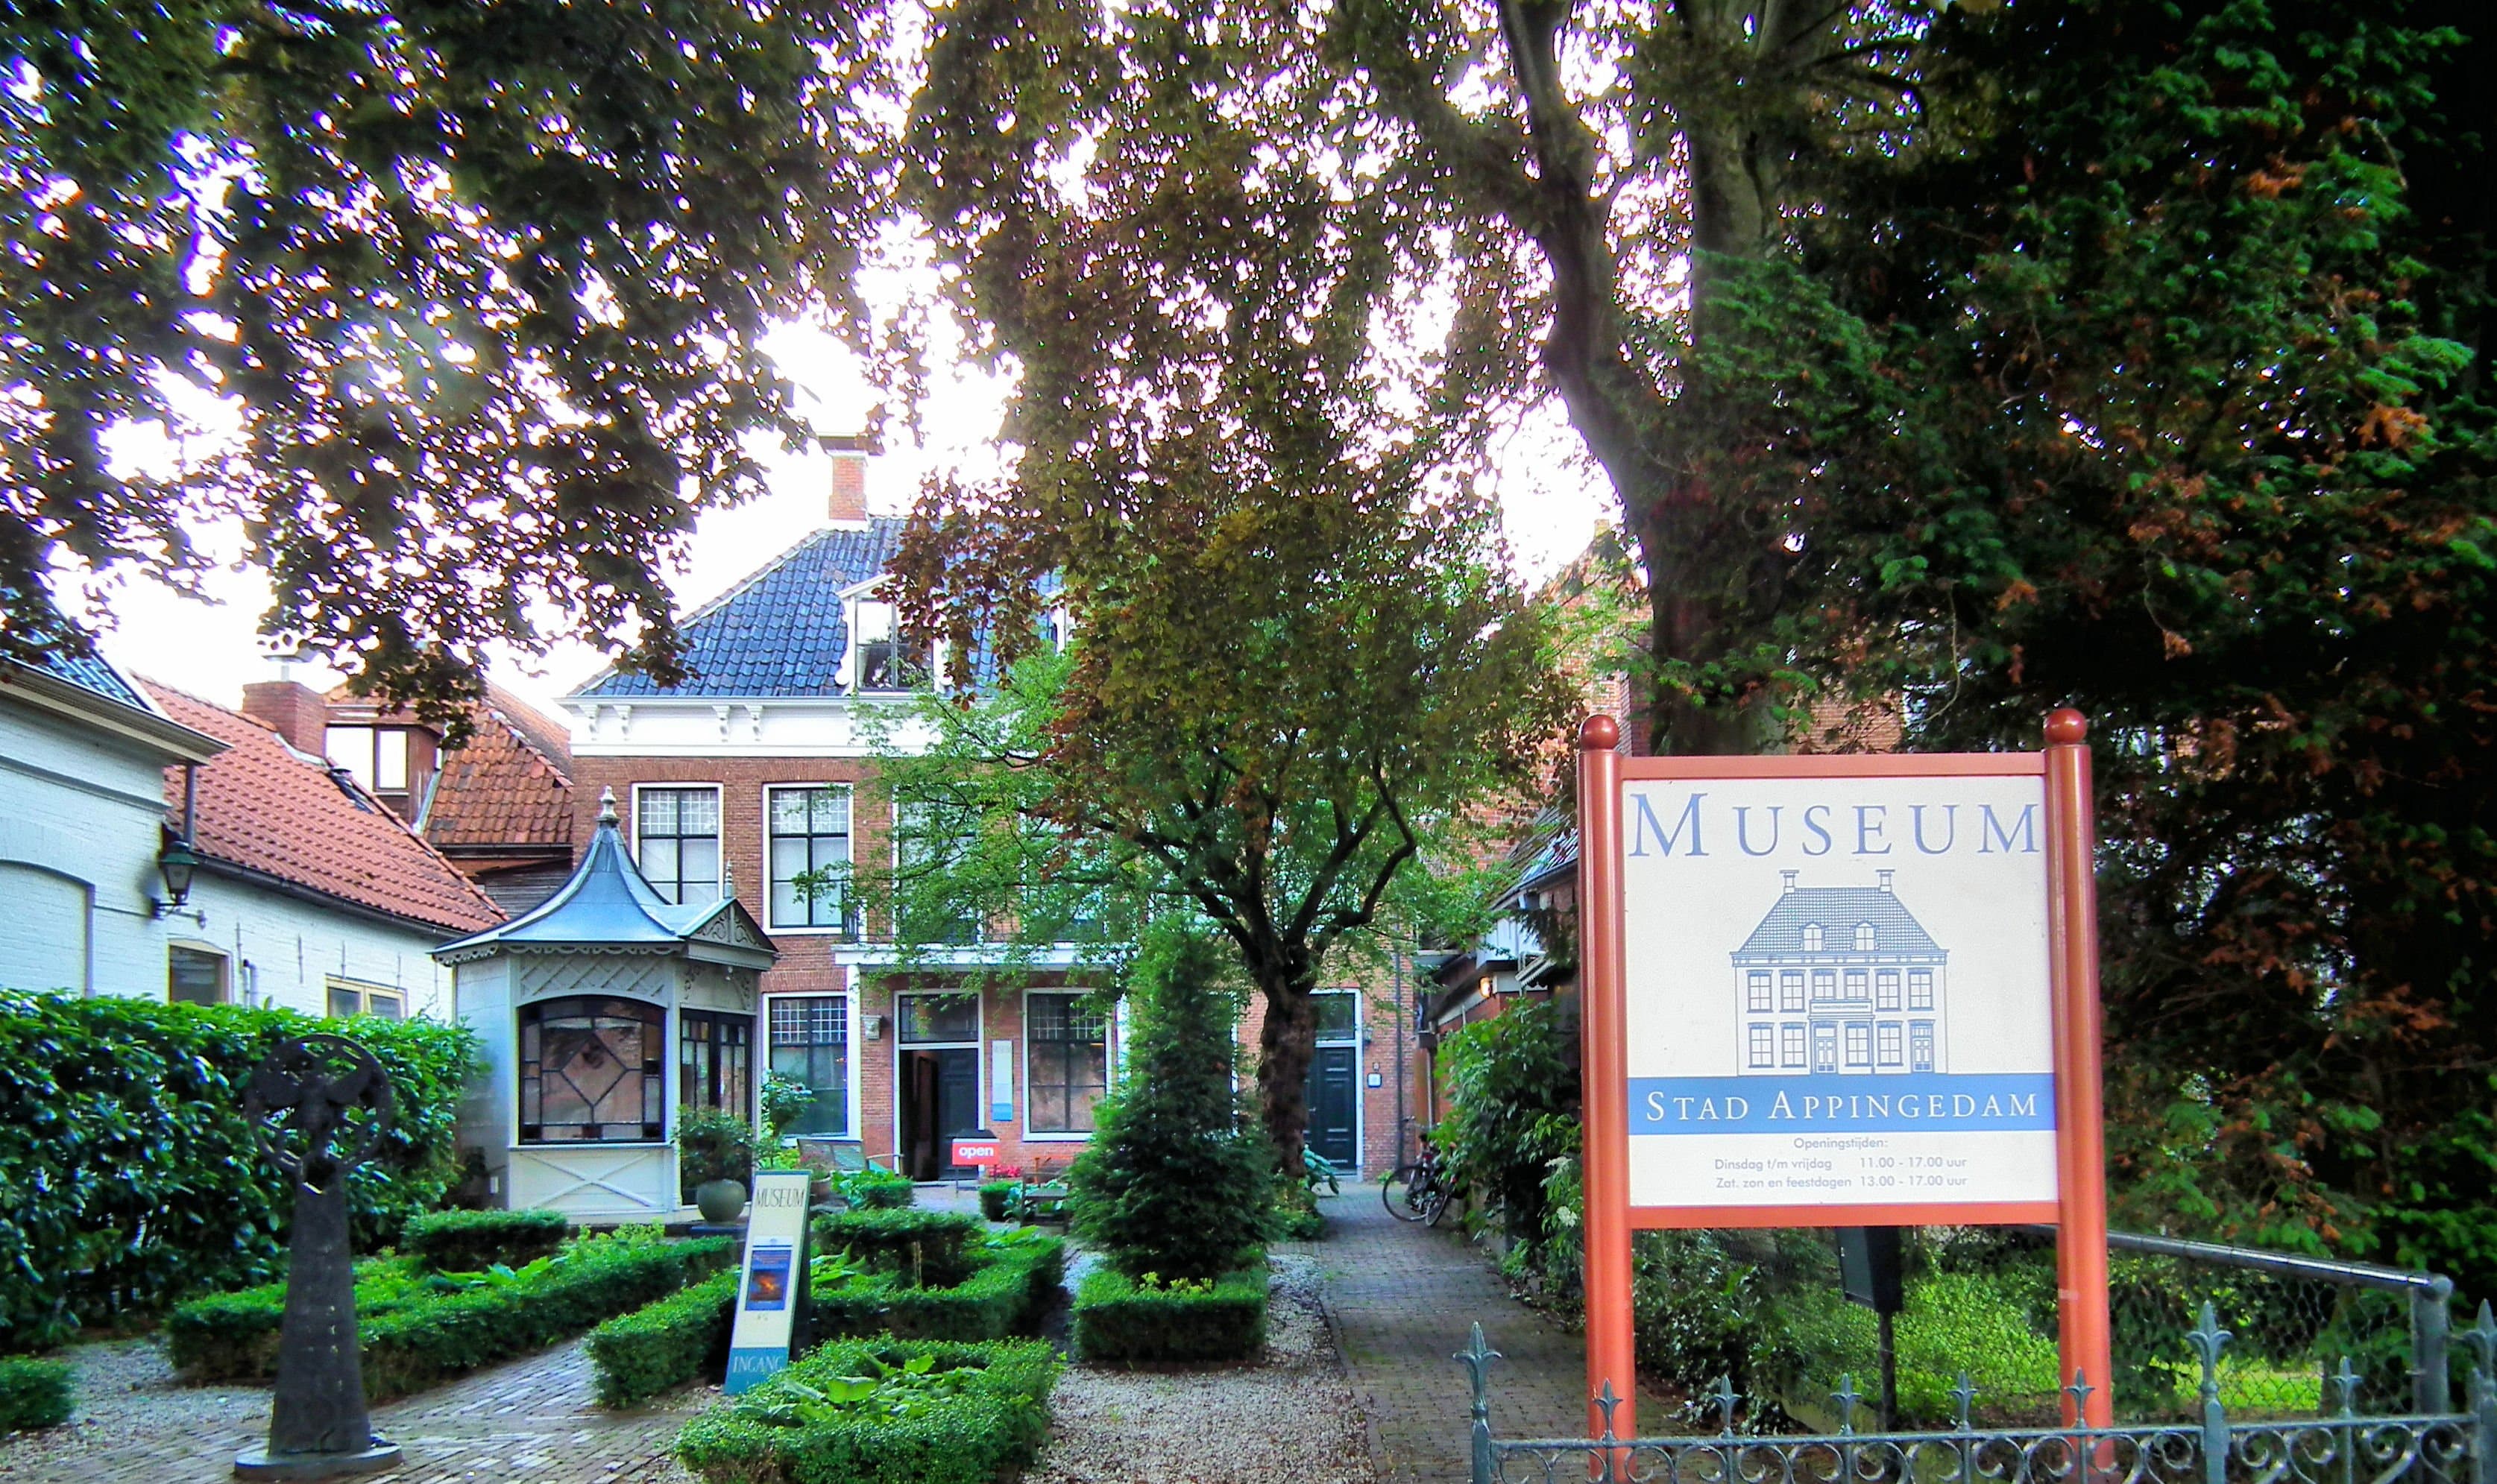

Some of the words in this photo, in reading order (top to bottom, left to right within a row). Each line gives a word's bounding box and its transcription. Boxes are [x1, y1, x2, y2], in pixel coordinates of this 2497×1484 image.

[1628, 792, 2041, 858] MUSEUM
[1646, 1090, 1749, 1121] STAD
[1767, 1090, 2038, 1120] APPINGEDAM
[1793, 1137, 1889, 1151] Openingstijden:
[958, 1146, 994, 1160] open
[1715, 1158, 1763, 1172] Dinsdag
[1767, 1158, 1788, 1170] t/m
[1791, 1158, 1832, 1172] vrijdag
[1860, 1157, 1895, 1169] 11.00
[1908, 1156, 1943, 1168] 17.00
[1947, 1158, 1968, 1168] uur
[1716, 1177, 1739, 1188] Zat.
[1743, 1179, 1764, 1188] zon
[1768, 1179, 1783, 1188] en
[1786, 1176, 1852, 1190] feestdagen
[1860, 1175, 1895, 1187] 13.00
[1908, 1175, 1944, 1187] 17.00
[1947, 1177, 1968, 1186] uur
[756, 1188, 805, 1207] MUSEUM
